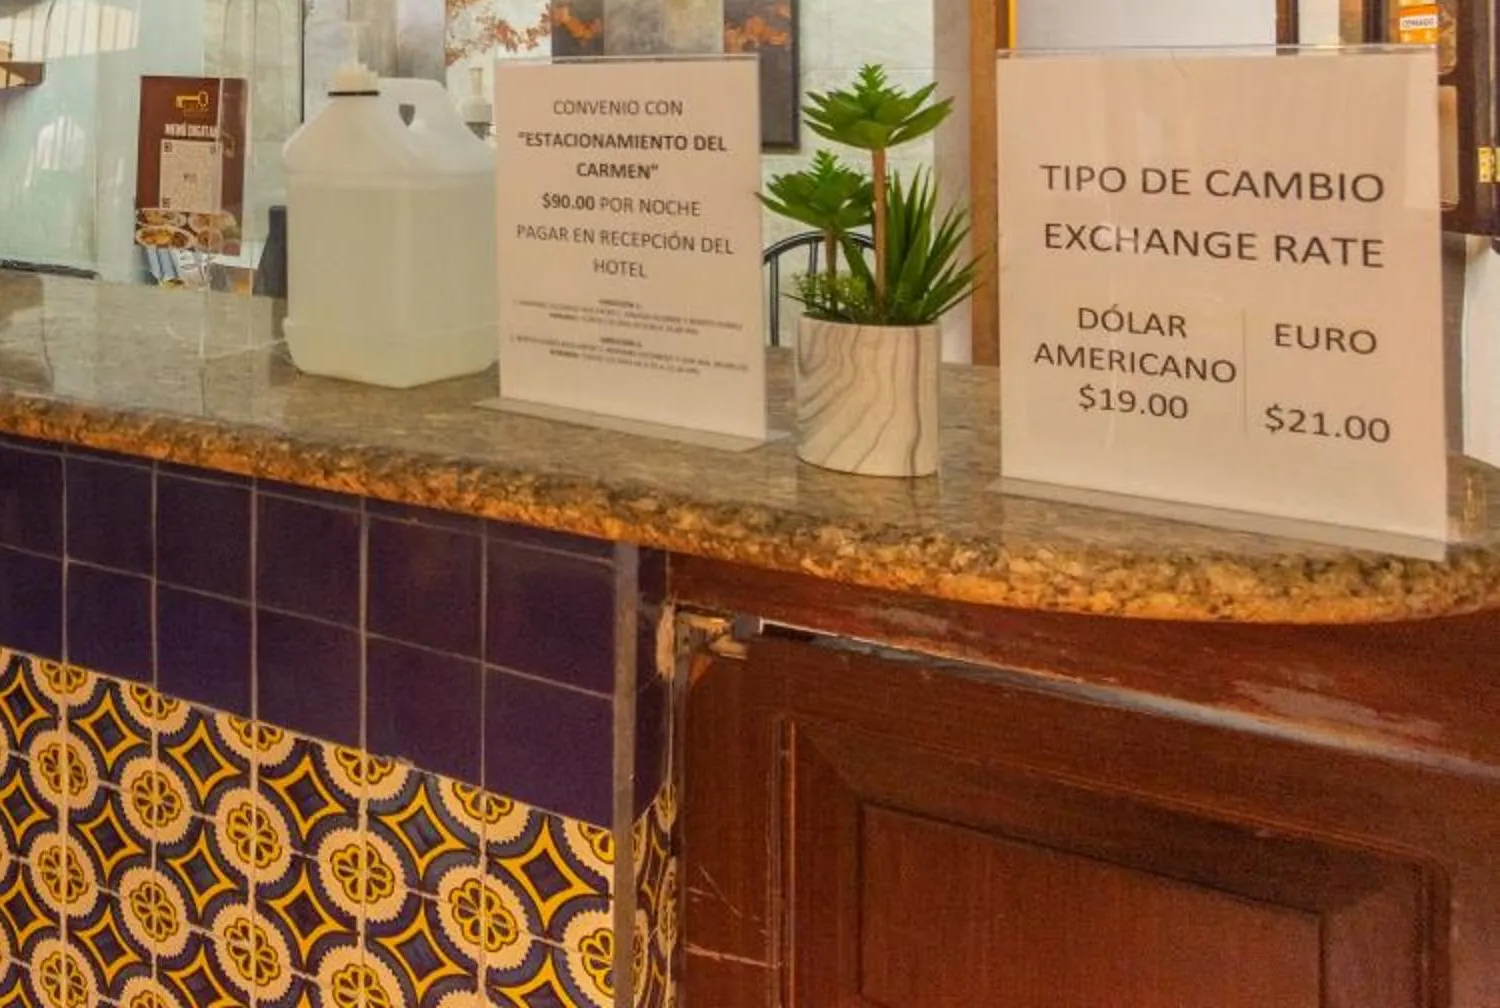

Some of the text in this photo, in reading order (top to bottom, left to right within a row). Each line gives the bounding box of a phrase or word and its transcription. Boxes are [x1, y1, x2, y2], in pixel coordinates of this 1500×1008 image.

[553, 99, 684, 116] CONVENIO CON
[693, 135, 728, 152] DEL
[576, 161, 659, 180] CARMEN"
[1040, 164, 1386, 204] TIPO DE CAMBIO
[541, 192, 702, 217] $90.00 POR NOCHE
[516, 223, 735, 255] PAGAR EN RECEPCIÓN DEL
[1043, 222, 1385, 268] EXCHANGE RATE
[593, 258, 648, 278] HOTEL
[1077, 303, 1188, 339] DÓLAR
[1274, 322, 1378, 355] EURO
[1033, 342, 1238, 384] AMERICANO
[1078, 383, 1189, 420] $19.00
[1264, 403, 1391, 444] $21.00
